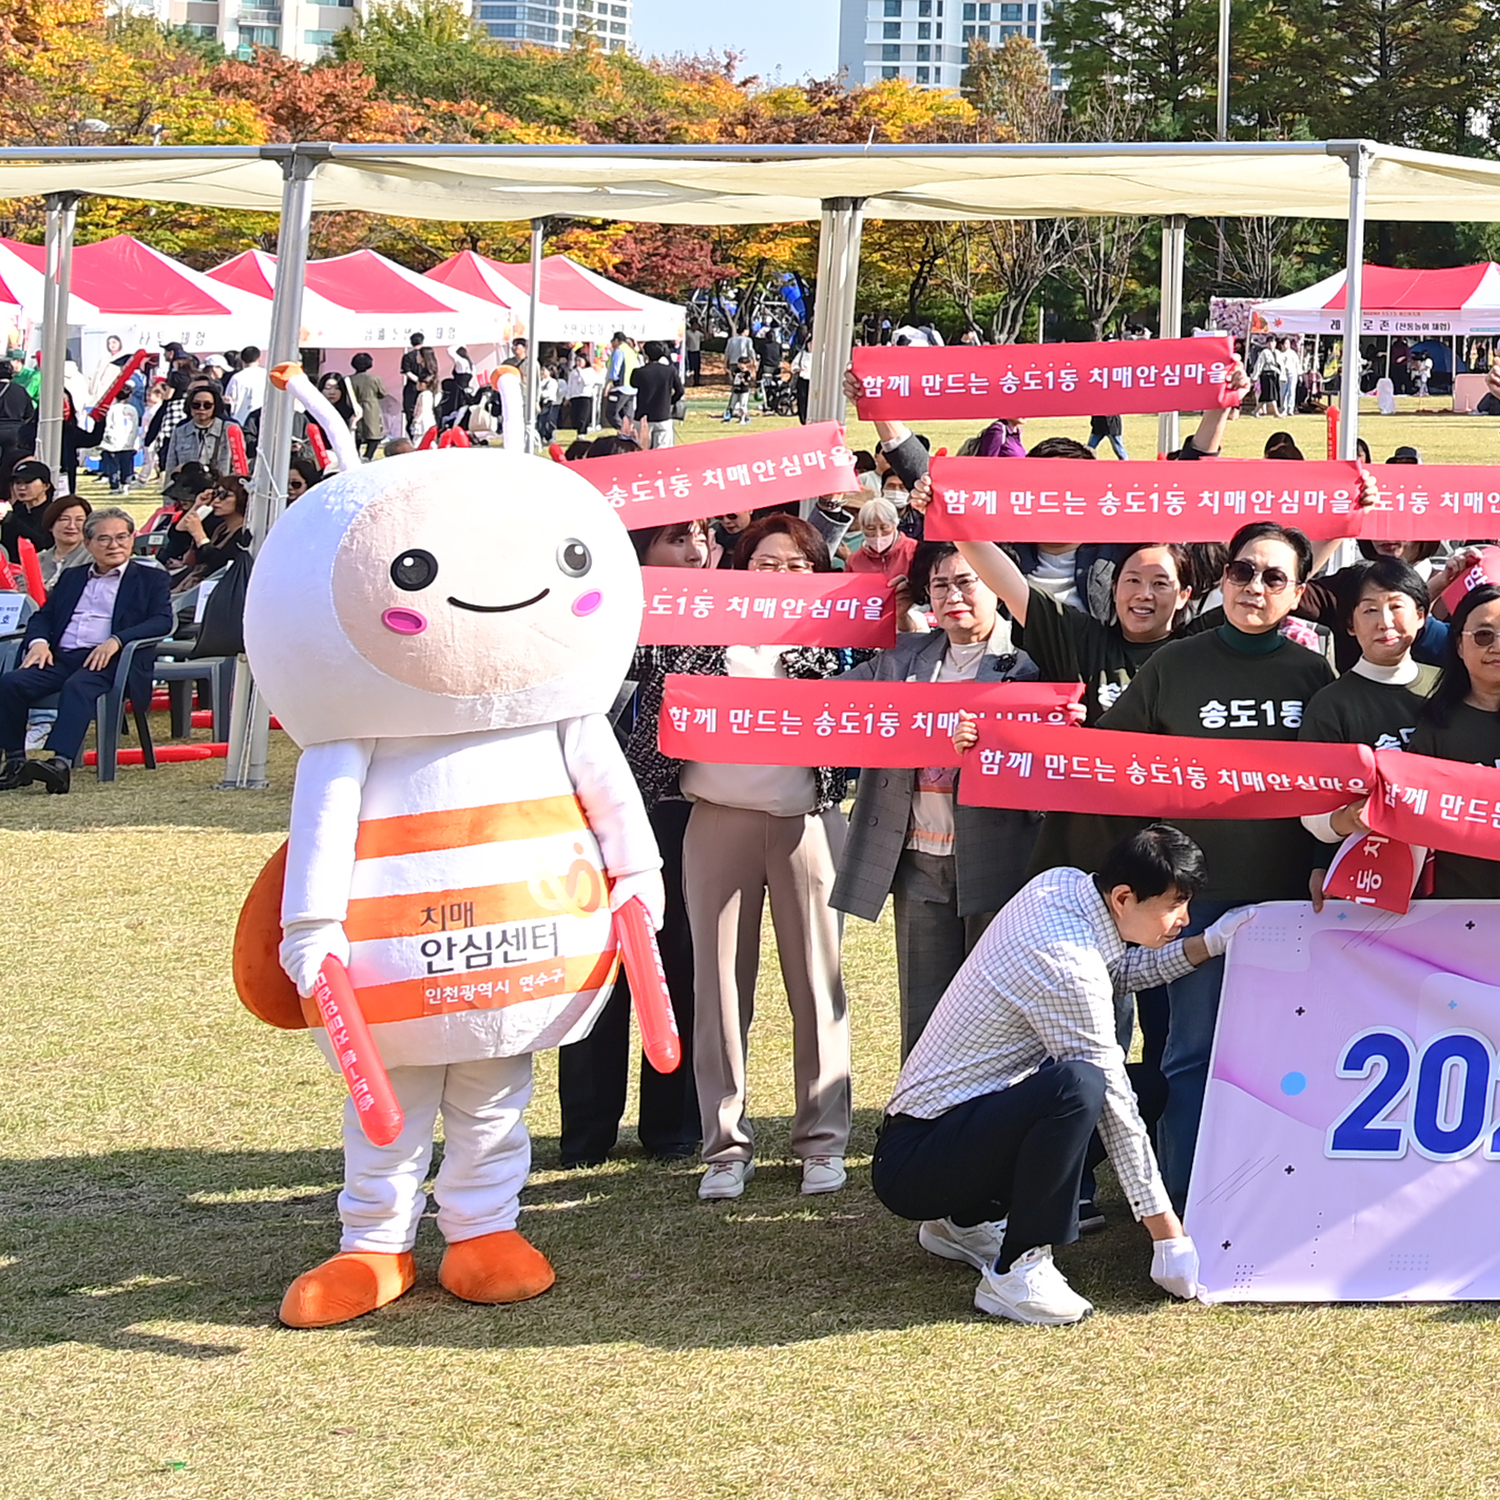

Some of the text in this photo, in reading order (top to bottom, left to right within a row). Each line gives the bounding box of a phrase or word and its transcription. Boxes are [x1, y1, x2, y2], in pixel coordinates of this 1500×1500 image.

[862, 362, 1226, 397] 함께 만드는 송도1동 치매안심마을
[604, 473, 692, 509] 송도1동
[942, 489, 1352, 516] 함께 만드는 송도1동 치매안심마을
[1374, 488, 1430, 514] 도1동
[641, 592, 882, 619] 도1동 치매안심마을
[668, 706, 717, 733] 함께
[729, 709, 802, 734] 만드는
[812, 710, 899, 737] 송도1동
[1199, 699, 1304, 729] 송도1동
[980, 748, 1032, 777] 함께
[1045, 754, 1116, 782] 만드는
[1126, 761, 1207, 789] 송도1동
[420, 902, 475, 931] 치매
[420, 922, 559, 974] 안심센터
[425, 968, 564, 1004] 인천광역시 연수구
[312, 971, 375, 1112] 송도1동 치매안심마
